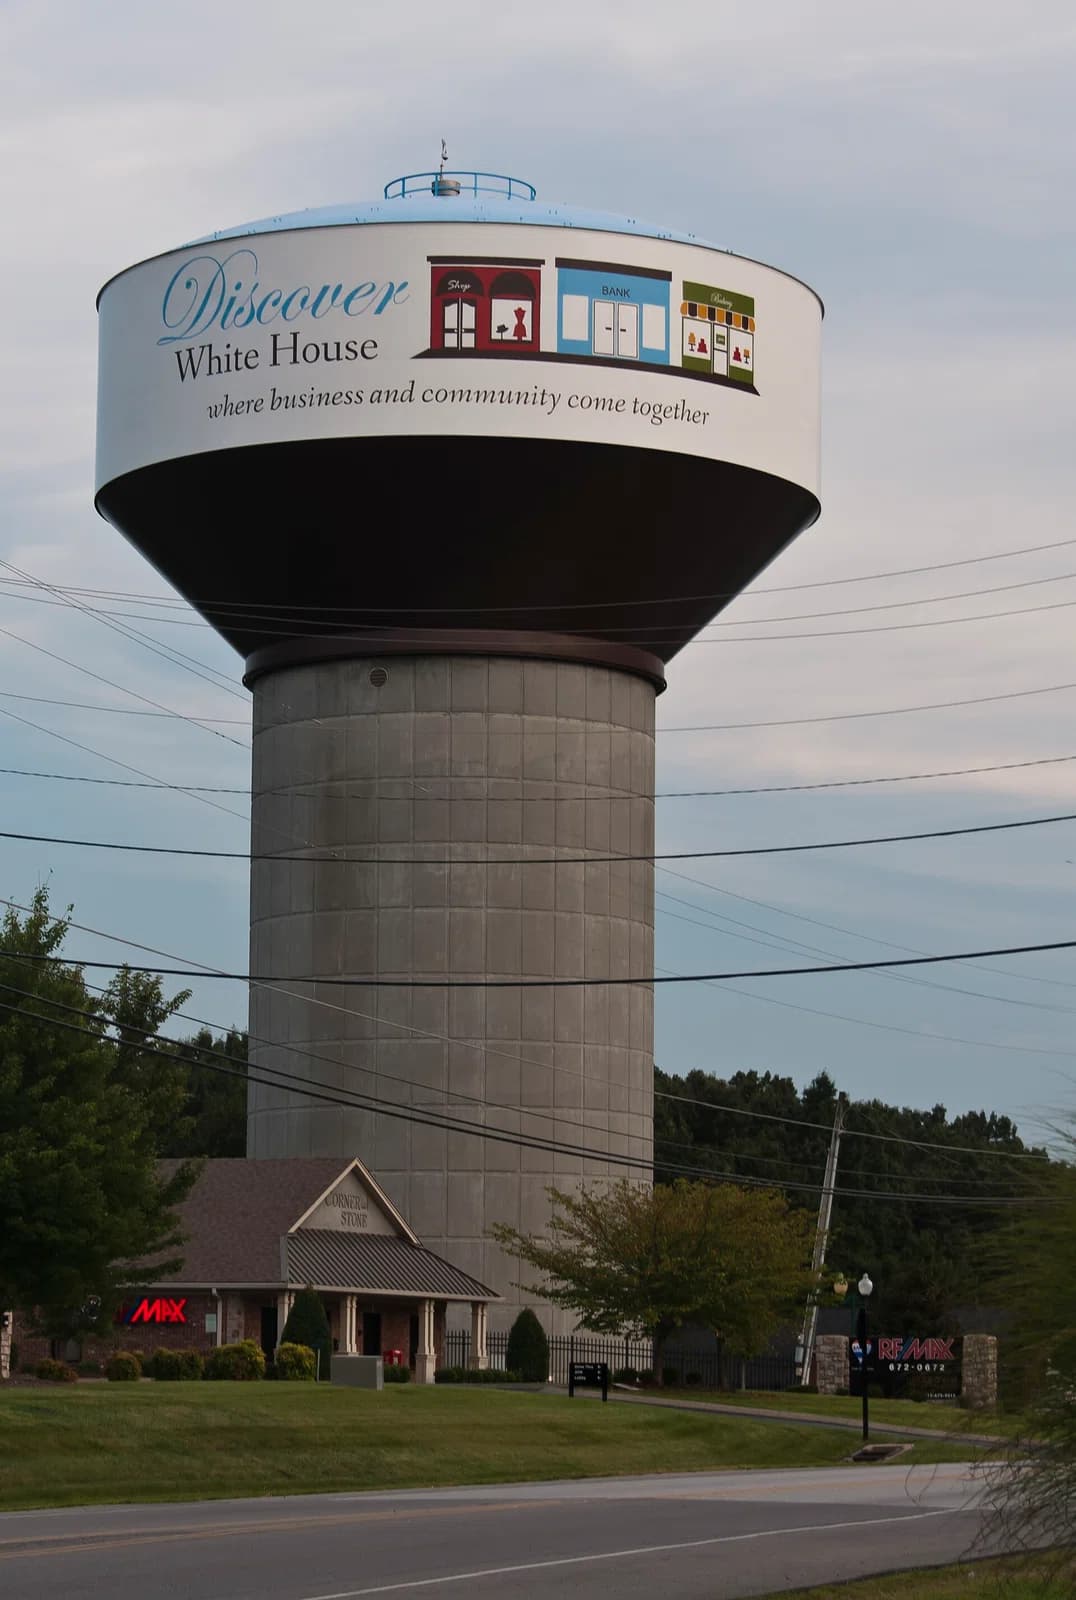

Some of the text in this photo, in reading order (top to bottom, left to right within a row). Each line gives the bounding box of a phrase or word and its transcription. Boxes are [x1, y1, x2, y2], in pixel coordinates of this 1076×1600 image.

[157, 250, 410, 346] Discover
[448, 279, 472, 292] Shop
[601, 285, 631, 298] BANK
[175, 331, 379, 384] White House
[206, 380, 710, 425] where business and community come together
[340, 1211, 368, 1229] STONE
